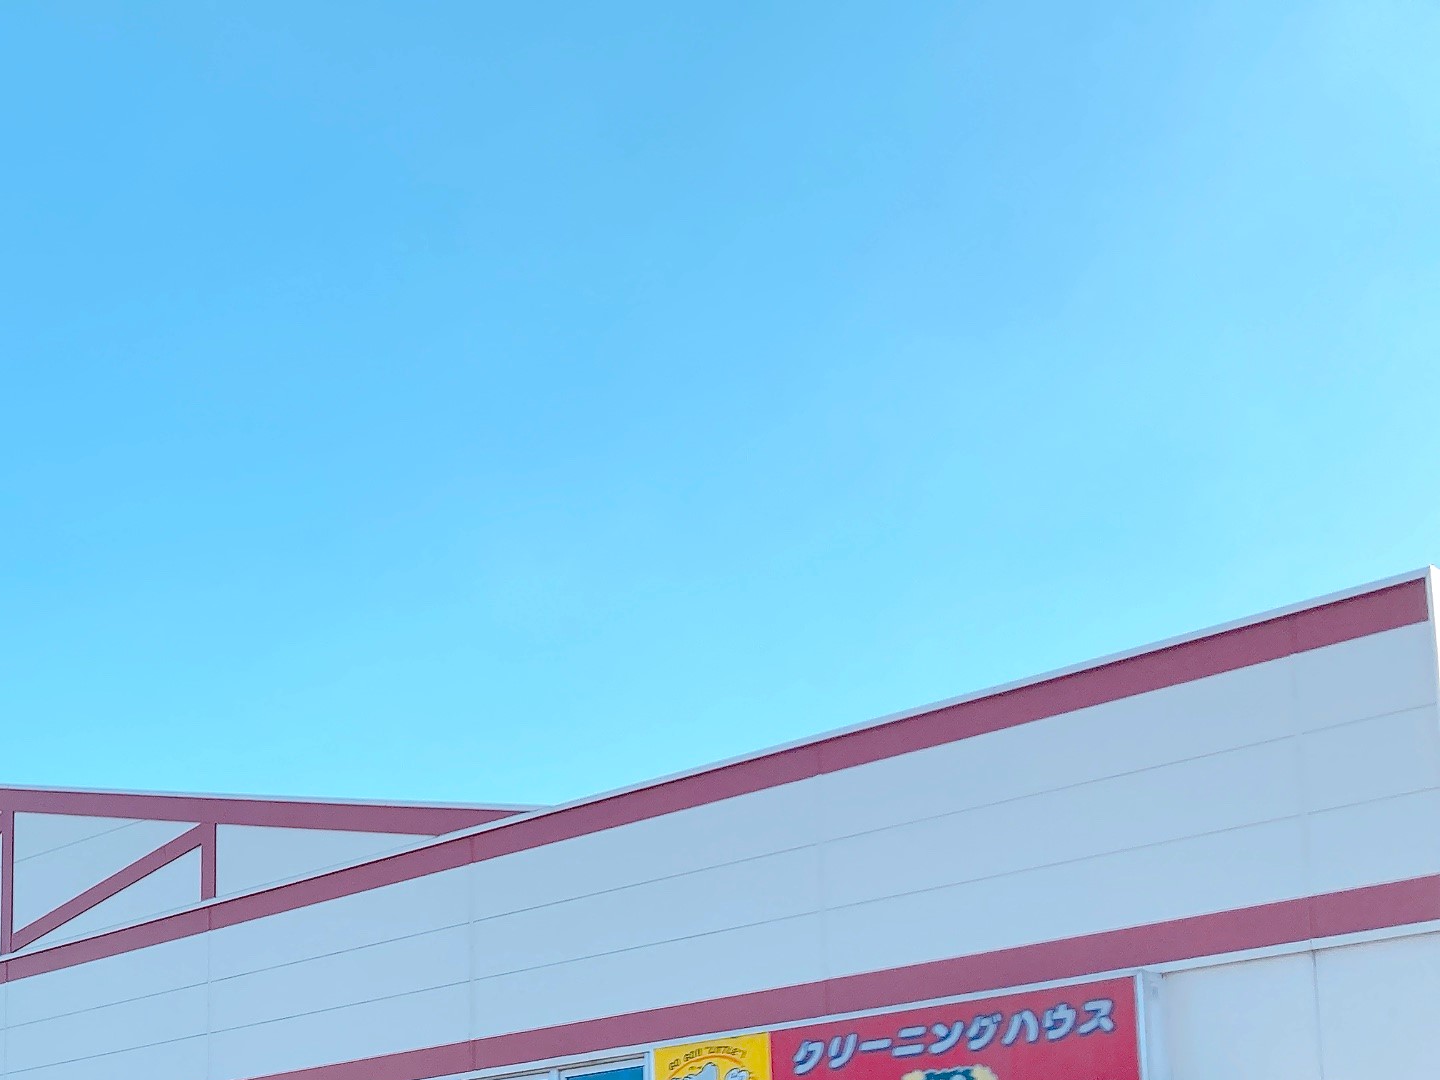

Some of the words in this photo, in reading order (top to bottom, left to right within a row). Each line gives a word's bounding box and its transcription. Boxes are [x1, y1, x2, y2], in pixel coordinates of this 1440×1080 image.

[792, 999, 1115, 1075] クリーニングハウス
